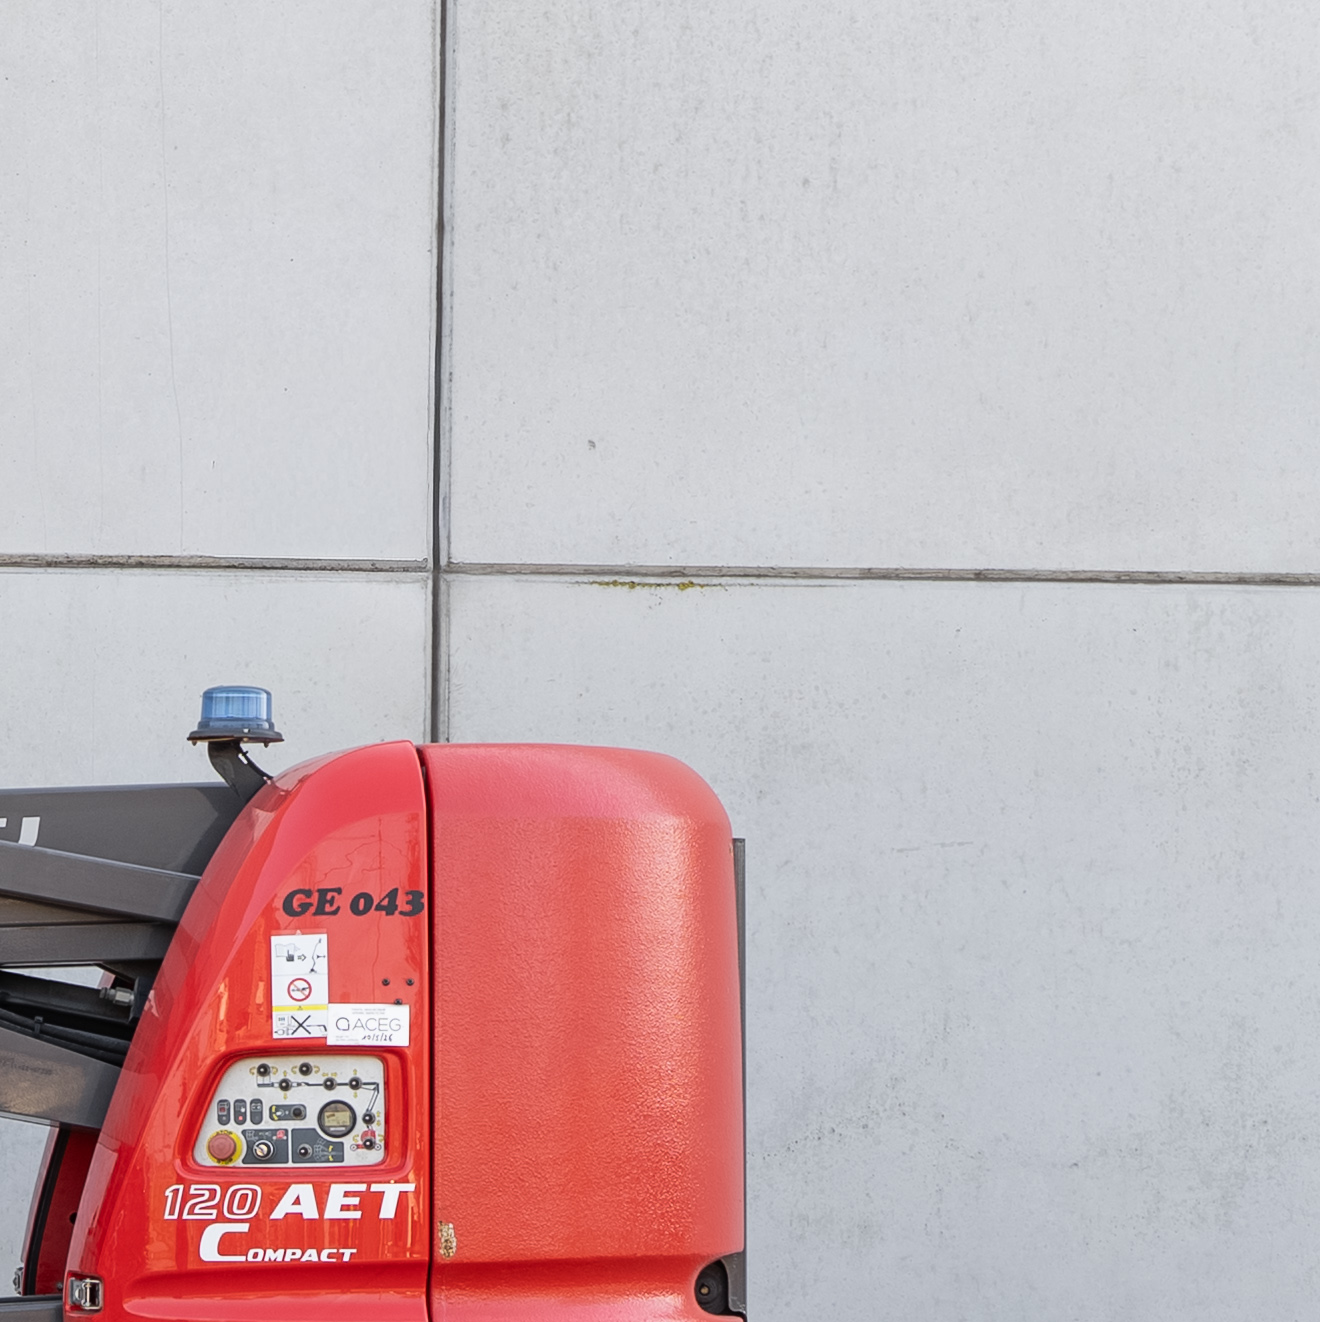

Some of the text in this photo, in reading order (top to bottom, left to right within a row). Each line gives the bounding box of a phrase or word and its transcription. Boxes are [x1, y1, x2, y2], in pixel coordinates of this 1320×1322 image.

[282, 887, 425, 917] GE 043
[163, 1183, 416, 1220] 120 AET
